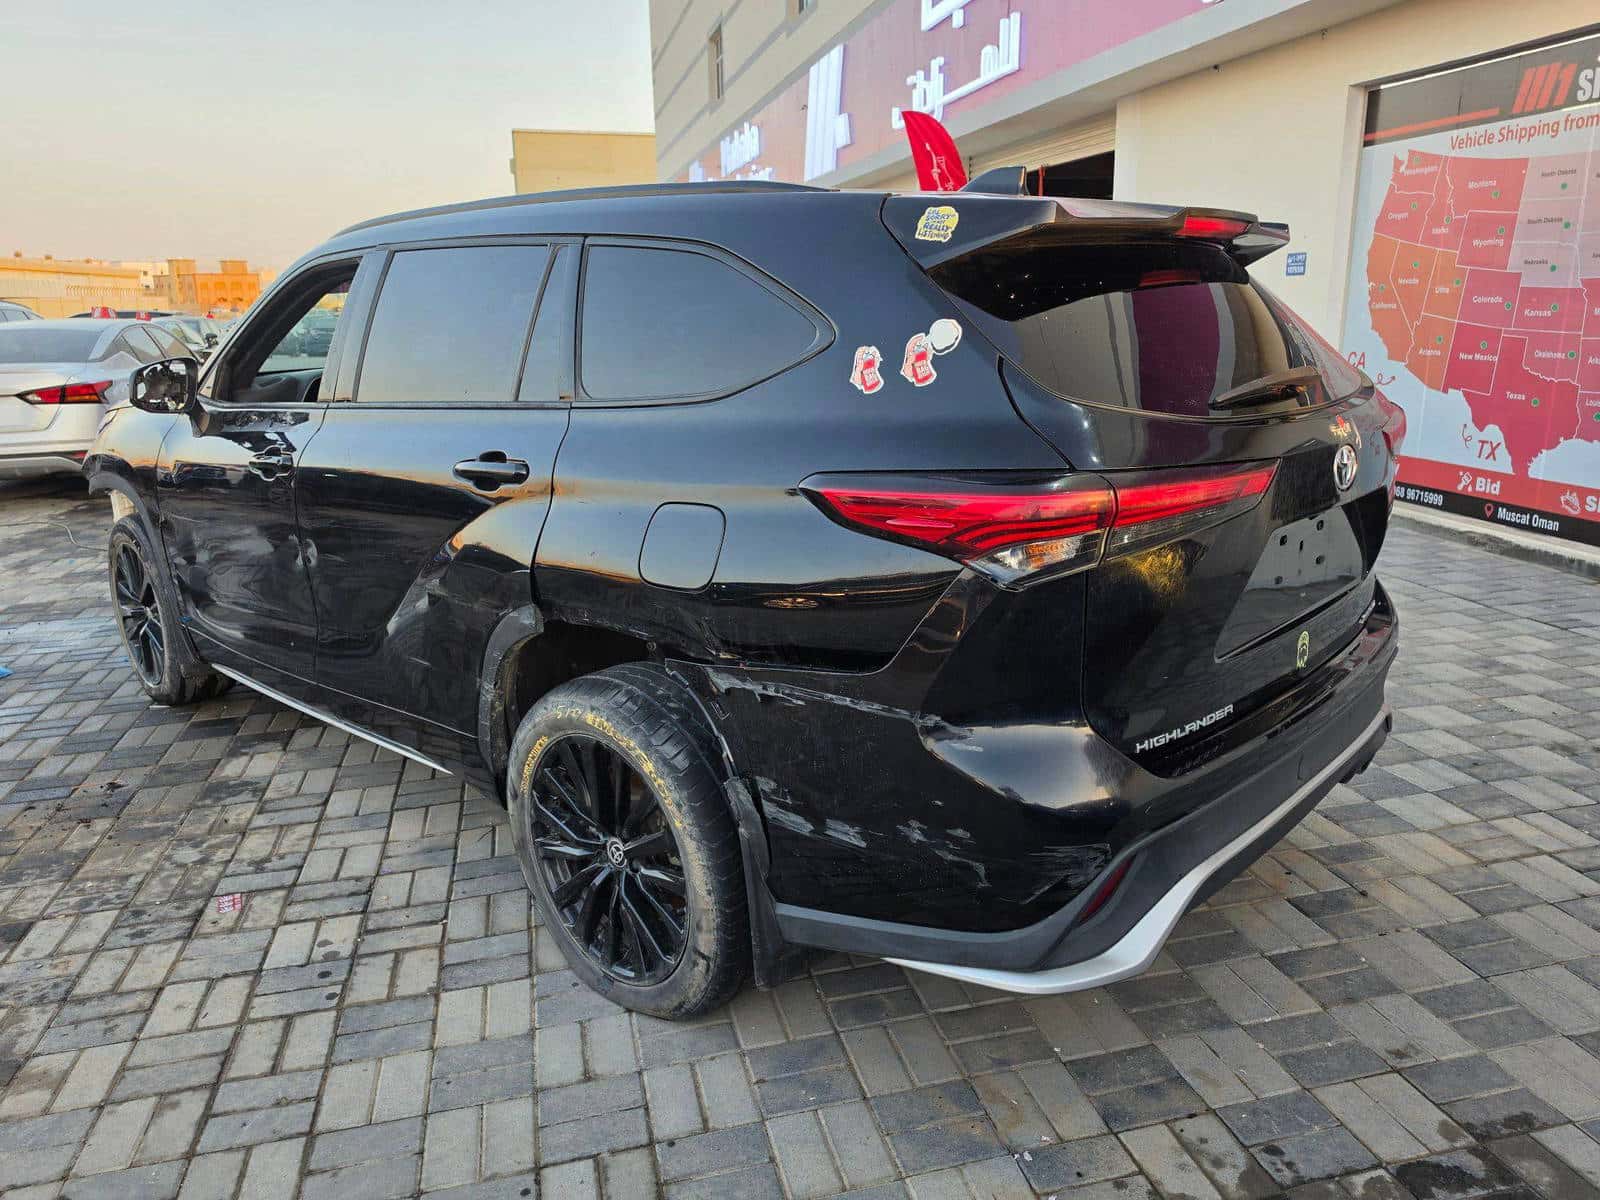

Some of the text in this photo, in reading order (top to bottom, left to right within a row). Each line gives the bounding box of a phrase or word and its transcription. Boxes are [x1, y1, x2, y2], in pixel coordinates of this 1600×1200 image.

[1450, 113, 1600, 150] Vehicle Shipping from
[1468, 180, 1497, 189] Montana
[1472, 238, 1504, 249] Wyoming
[1398, 277, 1419, 285] Nevada
[1473, 295, 1503, 304] Colorado
[1524, 309, 1551, 317] Kansas
[1459, 352, 1498, 362] New Mexico
[1534, 350, 1566, 359] Oklahoma
[1506, 391, 1526, 401] Texas
[1477, 439, 1502, 461] TX
[1475, 477, 1500, 496] Bid
[1497, 507, 1560, 532] Muscat Oman
[1135, 703, 1234, 754] HIGHLANDER
